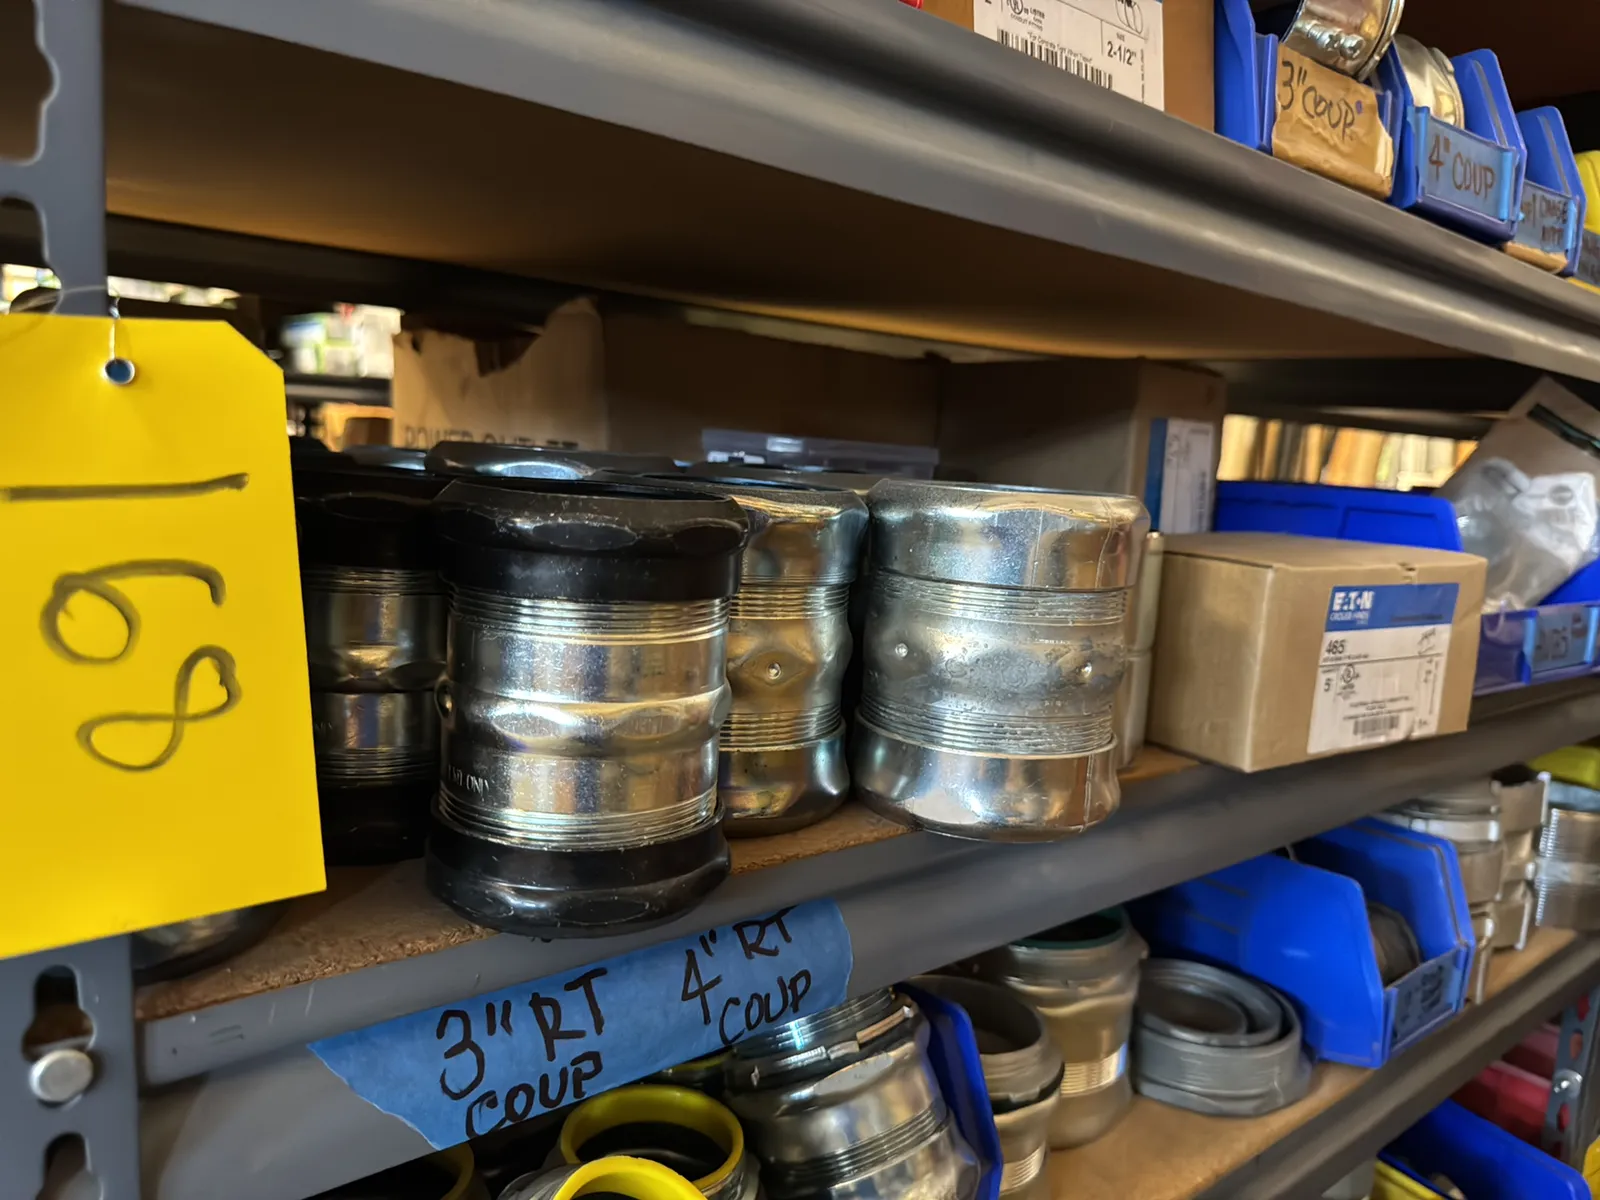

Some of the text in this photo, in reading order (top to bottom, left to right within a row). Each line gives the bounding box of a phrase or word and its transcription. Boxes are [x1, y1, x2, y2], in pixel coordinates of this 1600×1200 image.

[1281, 60, 1356, 141] 3" COUP
[1428, 133, 1495, 199] 4" COUP
[681, 907, 797, 1026] 4" RT
[718, 969, 811, 1046] COUP
[436, 968, 607, 1100] 3" RT
[465, 1051, 604, 1140] COUP
